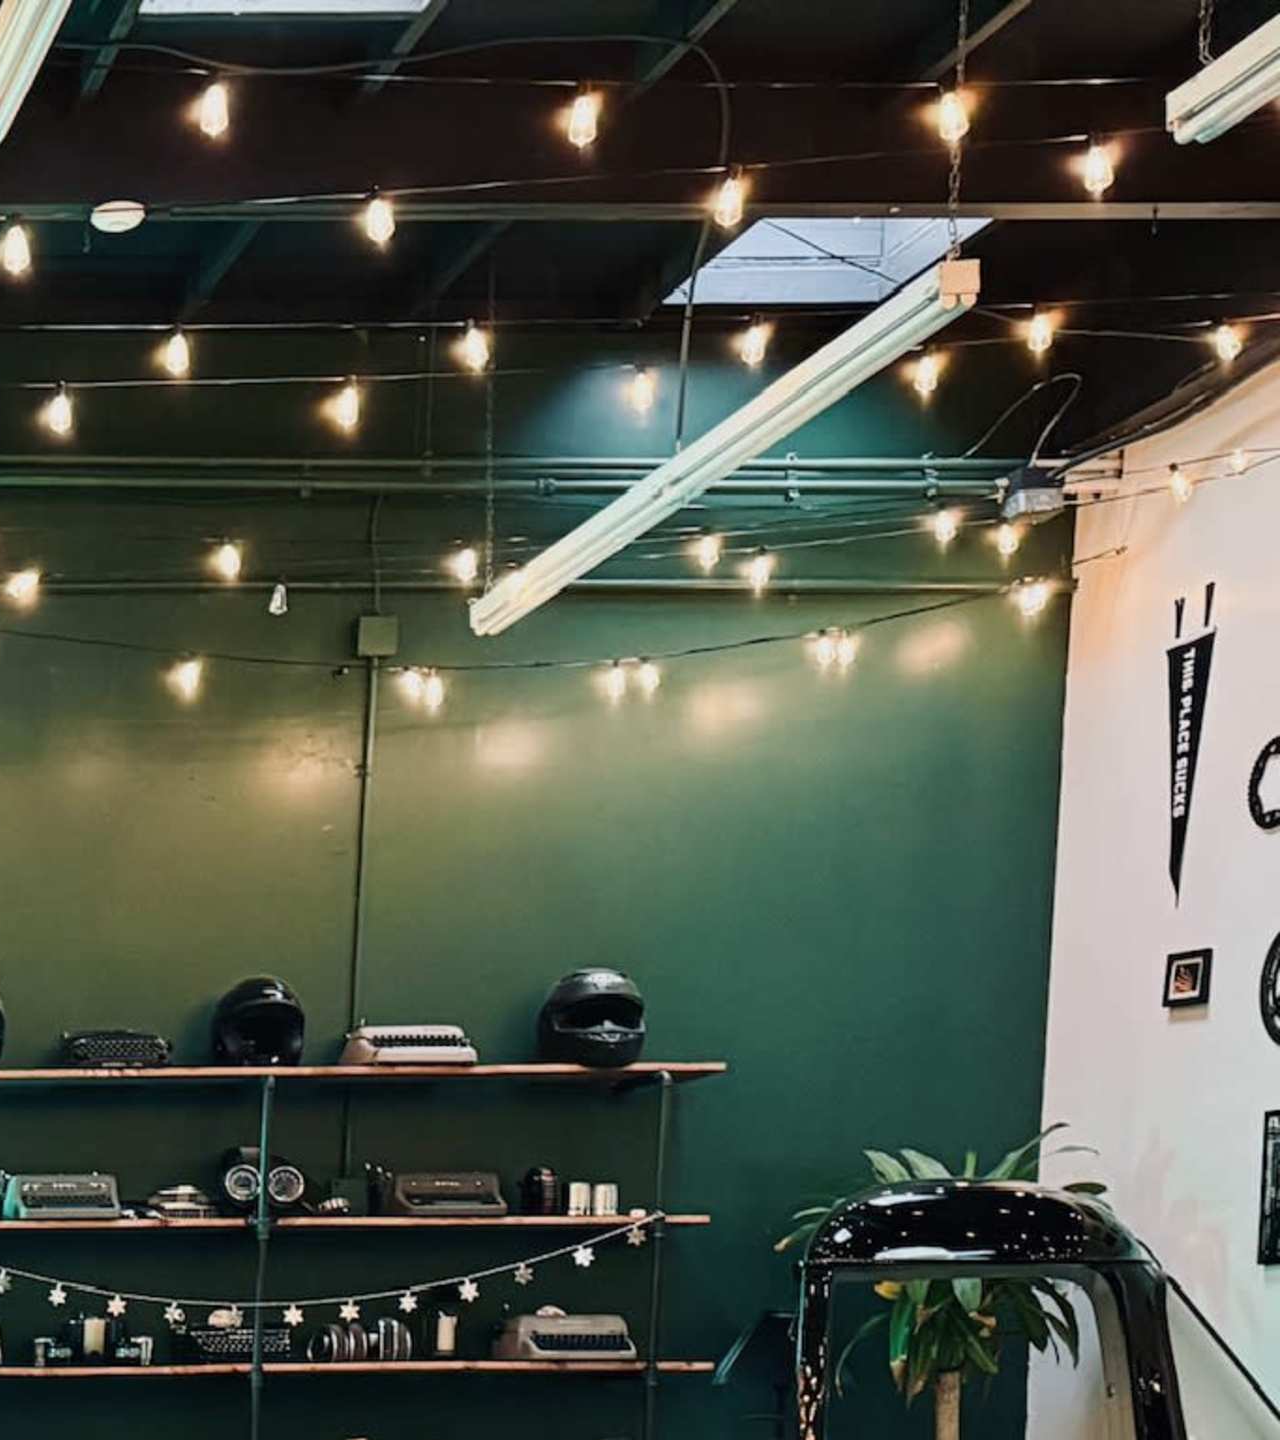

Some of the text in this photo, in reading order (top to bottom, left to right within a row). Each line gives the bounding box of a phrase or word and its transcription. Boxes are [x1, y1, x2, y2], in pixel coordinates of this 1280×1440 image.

[1172, 647, 1196, 819] THIS PLACE SUCKS
